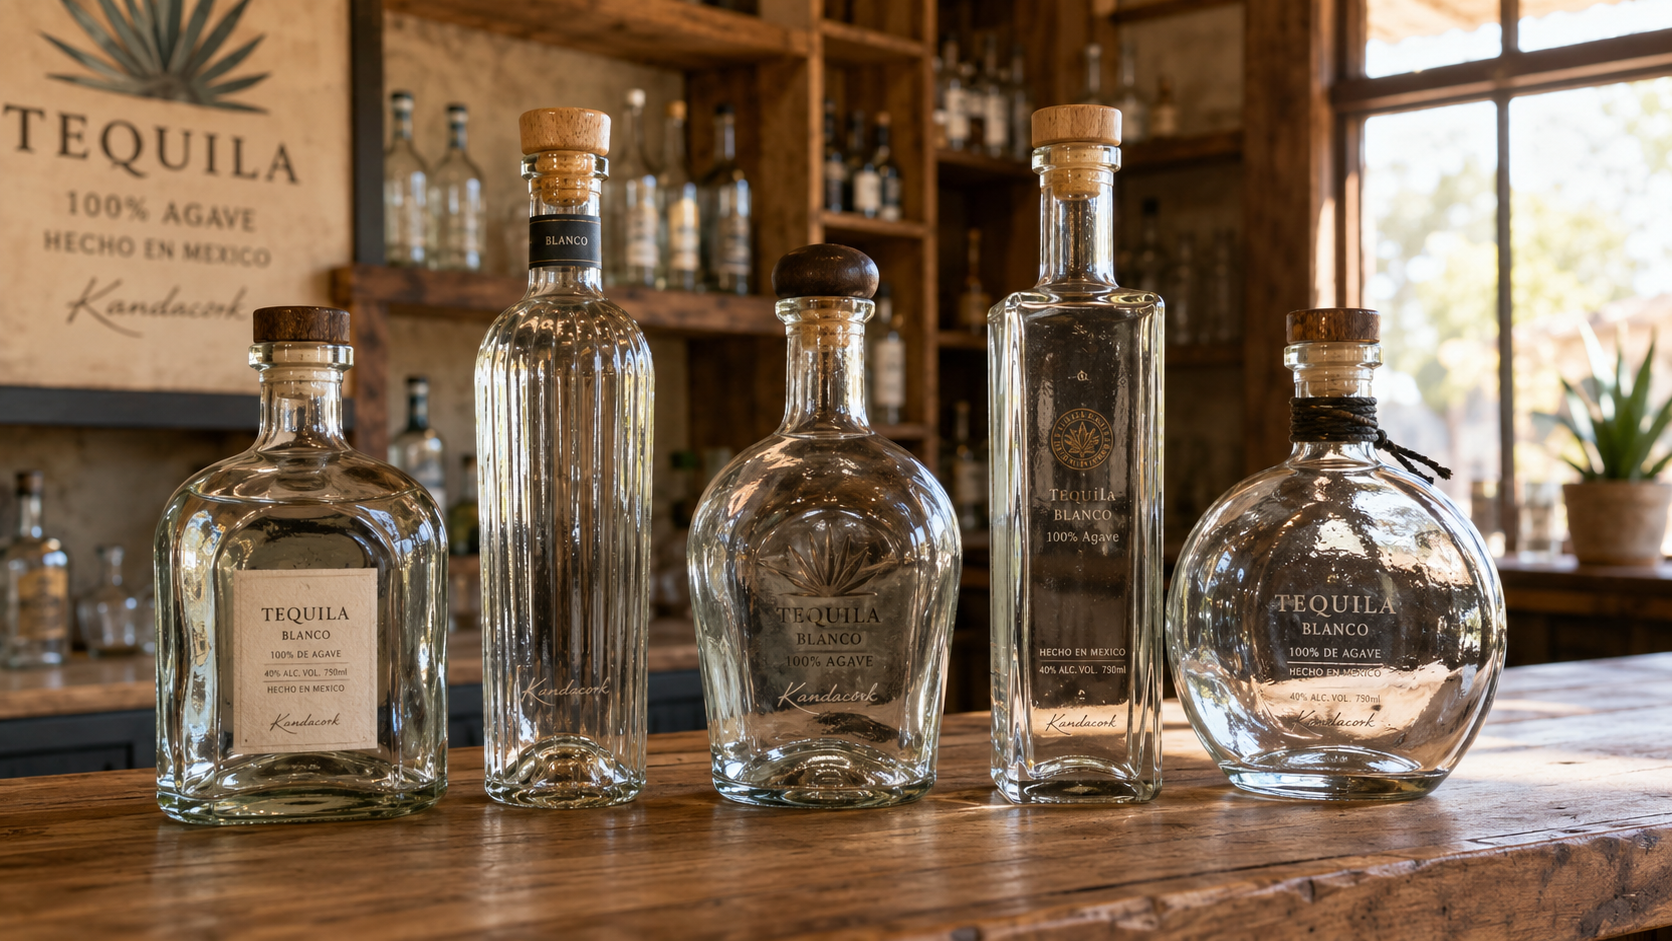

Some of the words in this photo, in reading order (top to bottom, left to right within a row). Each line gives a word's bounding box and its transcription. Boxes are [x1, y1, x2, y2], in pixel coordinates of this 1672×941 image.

[3, 103, 302, 186] TEQUILA
[66, 190, 149, 223] 100%
[161, 201, 257, 233] AGAVE
[545, 235, 588, 246] BLANCO
[43, 229, 136, 259] HECHO
[144, 236, 175, 261] EN
[181, 240, 272, 269] MEXICO
[66, 276, 250, 338] Kandacork
[1054, 509, 1112, 521] BLANCO
[1046, 531, 1078, 543] 100%
[1082, 531, 1120, 546] Agave
[1274, 594, 1397, 618] TEQUILA
[261, 606, 350, 625] TEQUILA
[776, 607, 881, 628] TEQUILA
[282, 630, 331, 641] BLANCO
[1302, 622, 1369, 636] BLANCO
[796, 633, 862, 645] BLANCO
[271, 651, 294, 659] 100%
[297, 650, 309, 659] DE
[312, 650, 342, 658] AGAVE
[1039, 648, 1072, 657] HECHO
[1075, 648, 1087, 657] EN
[1090, 648, 1126, 657] MEXICO
[1289, 647, 1319, 657] 100%
[1323, 647, 1338, 658] DE
[1342, 648, 1382, 659] AGAVE
[787, 655, 820, 667] 100%
[826, 655, 874, 667] AGAVE
[264, 669, 281, 677] 40%
[283, 669, 301, 677] ALC.
[302, 668, 321, 677] VOL.
[1039, 665, 1057, 674] 40%
[1058, 665, 1077, 674] ALC.
[1078, 665, 1098, 674] VOL.
[1289, 667, 1324, 677] HECHO
[1326, 668, 1340, 677] EN
[1343, 668, 1382, 678] MEXICO
[267, 685, 297, 694] HECHO
[299, 685, 310, 693] EN
[313, 684, 345, 693] MEXICO
[521, 677, 611, 706] Kandacork
[777, 681, 879, 716] Kandacork
[1289, 692, 1308, 701] 40%
[1310, 693, 1330, 702] ALC.
[1331, 694, 1352, 703] VOL.
[269, 713, 341, 734] Kandacork
[1045, 713, 1117, 736] Kandacork
